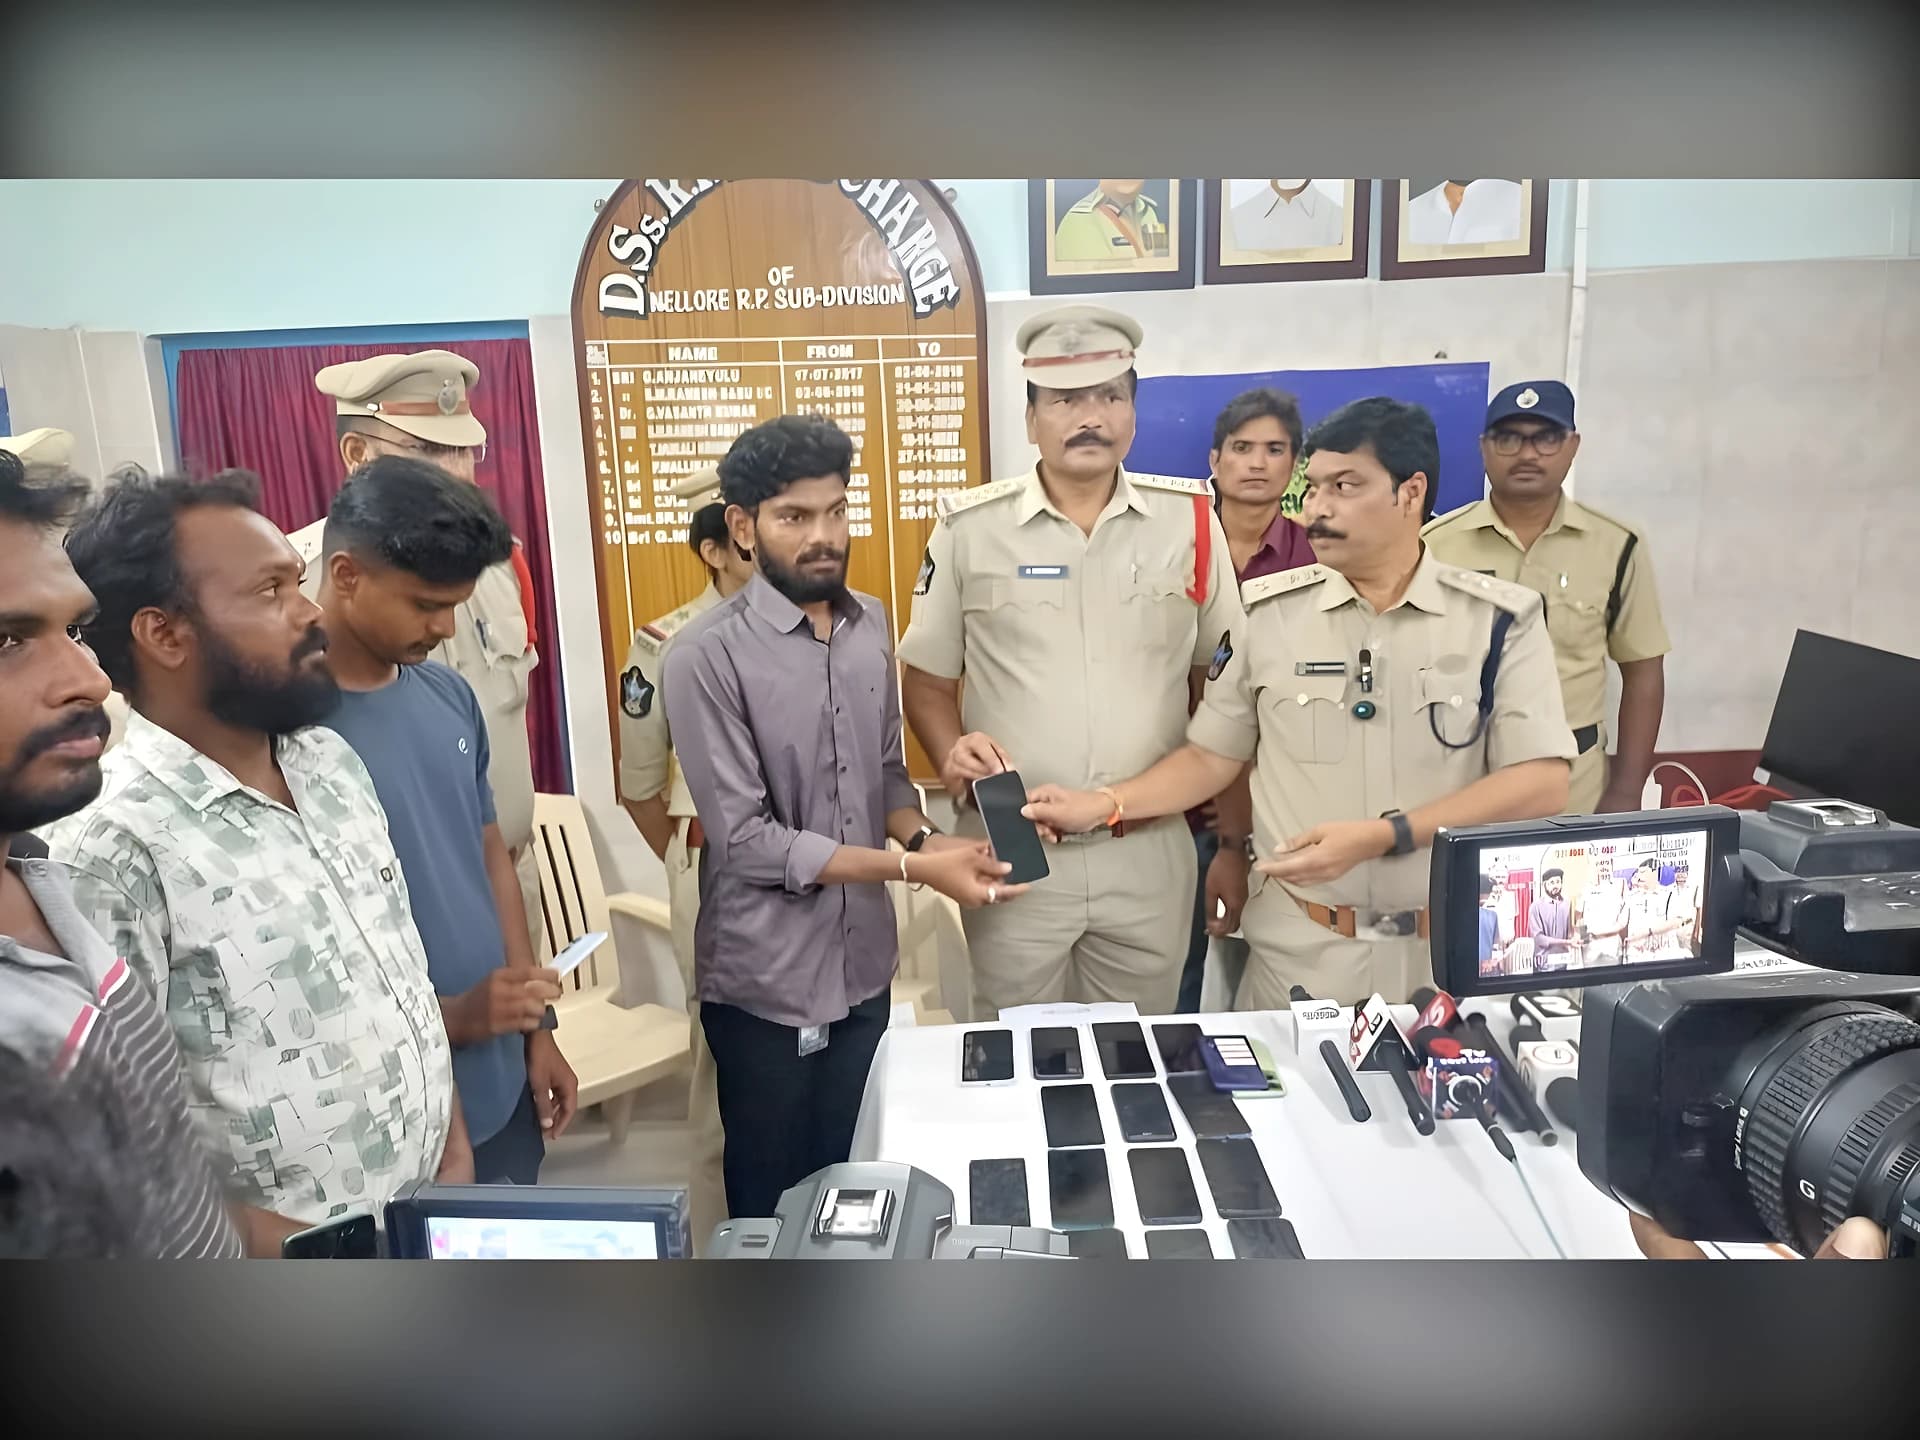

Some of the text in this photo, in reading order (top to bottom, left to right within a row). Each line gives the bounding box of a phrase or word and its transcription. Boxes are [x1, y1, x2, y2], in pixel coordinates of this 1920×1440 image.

[768, 266, 794, 287] OF
[650, 289, 729, 313] NELLORE
[774, 284, 905, 310] SUB-DIVISION
[807, 344, 854, 359] FROM
[918, 342, 941, 357] TO
[1799, 1178, 1815, 1200] G
